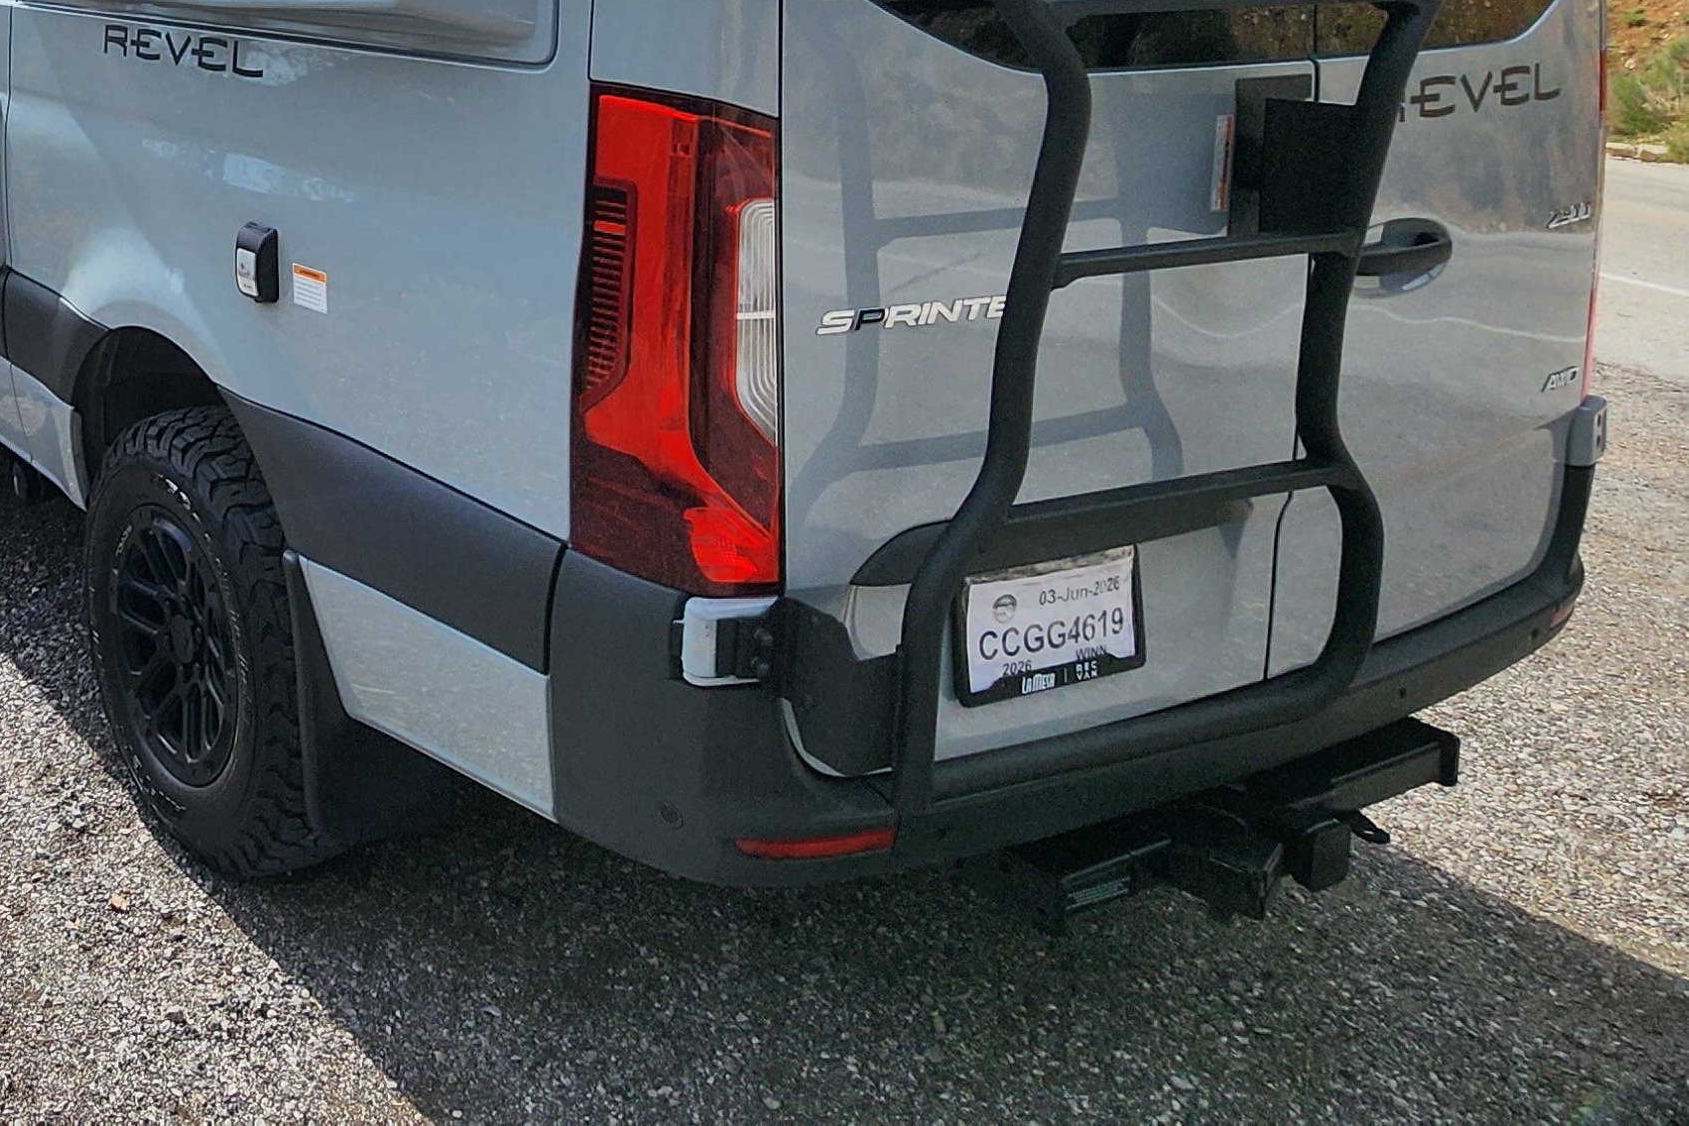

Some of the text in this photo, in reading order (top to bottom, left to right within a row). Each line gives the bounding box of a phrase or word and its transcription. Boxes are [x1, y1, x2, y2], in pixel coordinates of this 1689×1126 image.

[104, 24, 263, 78] REVEL
[1399, 62, 1561, 123] EVEL
[815, 294, 1007, 335] SPRINTE
[1039, 575, 1120, 606] 03-Jun-2026
[979, 606, 1124, 661] CCGG4619
[1075, 644, 1107, 661] WINN
[1002, 659, 1033, 675] 2026
